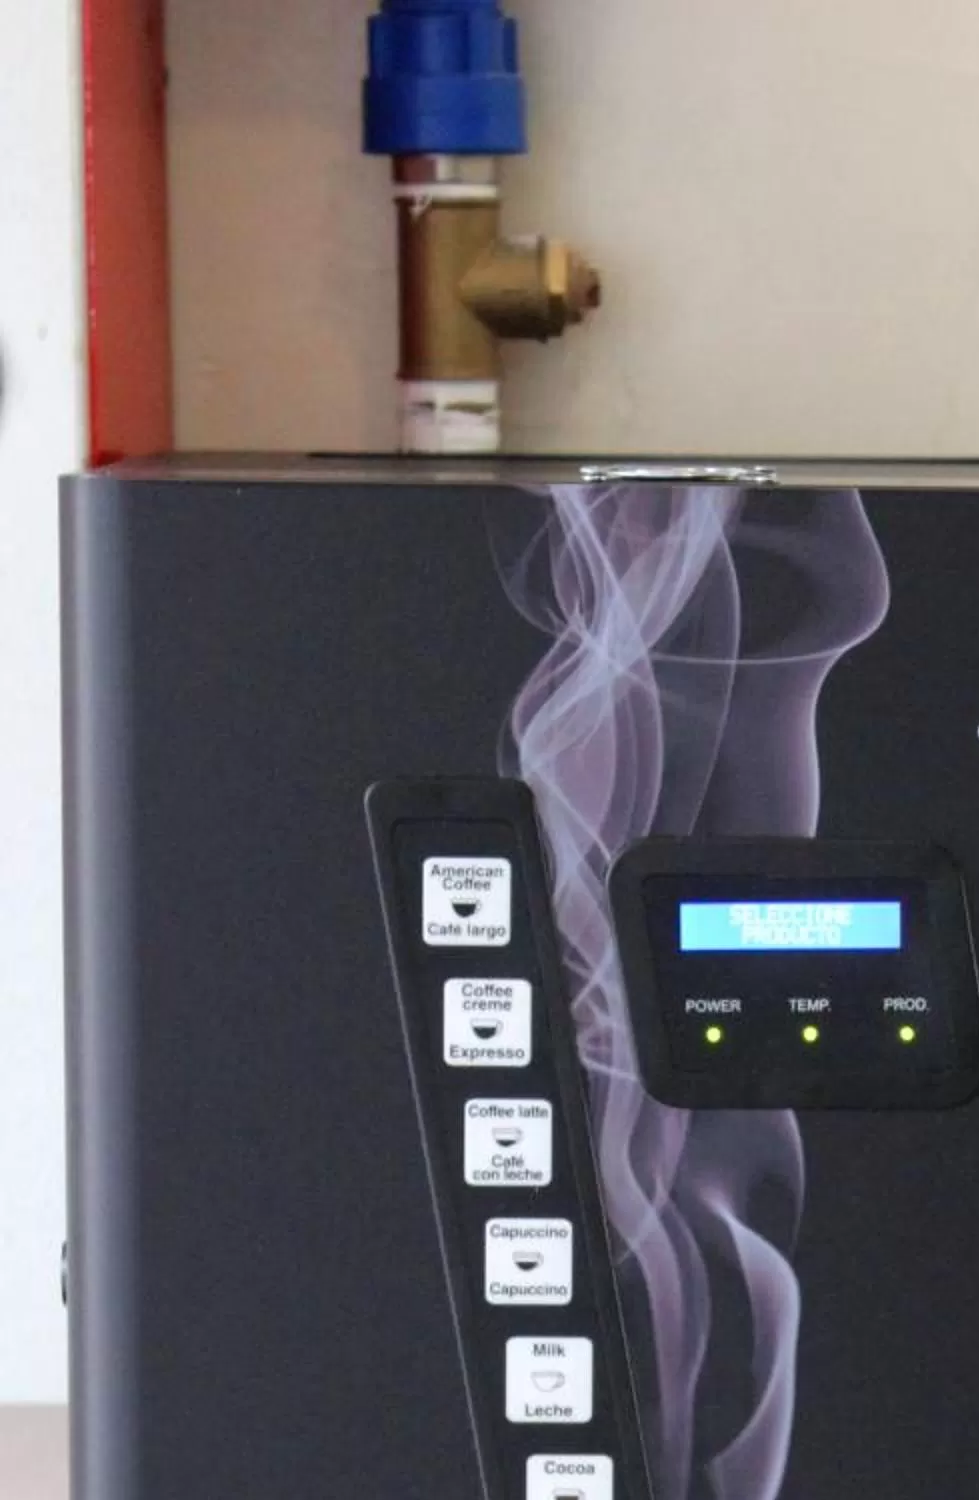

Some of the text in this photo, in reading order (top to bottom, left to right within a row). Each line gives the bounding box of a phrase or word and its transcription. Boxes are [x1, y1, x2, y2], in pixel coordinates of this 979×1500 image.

[430, 864, 504, 880] American
[442, 878, 491, 891] Coffee
[427, 923, 507, 939] Café largo
[461, 984, 513, 998] Coffee
[463, 1000, 513, 1011] creme
[685, 999, 742, 1013] POWER
[789, 999, 832, 1013] TEMP.
[883, 997, 931, 1012] PROD.
[448, 1044, 525, 1061] Expresso
[467, 1104, 549, 1119] Coffee latte
[491, 1155, 524, 1168] Café
[472, 1167, 543, 1181] con leche
[489, 1224, 569, 1241] Capuccino
[489, 1282, 568, 1298] Capuccino
[532, 1343, 566, 1357] Milk
[524, 1404, 573, 1418] Leche
[543, 1461, 595, 1475] Cocoa
